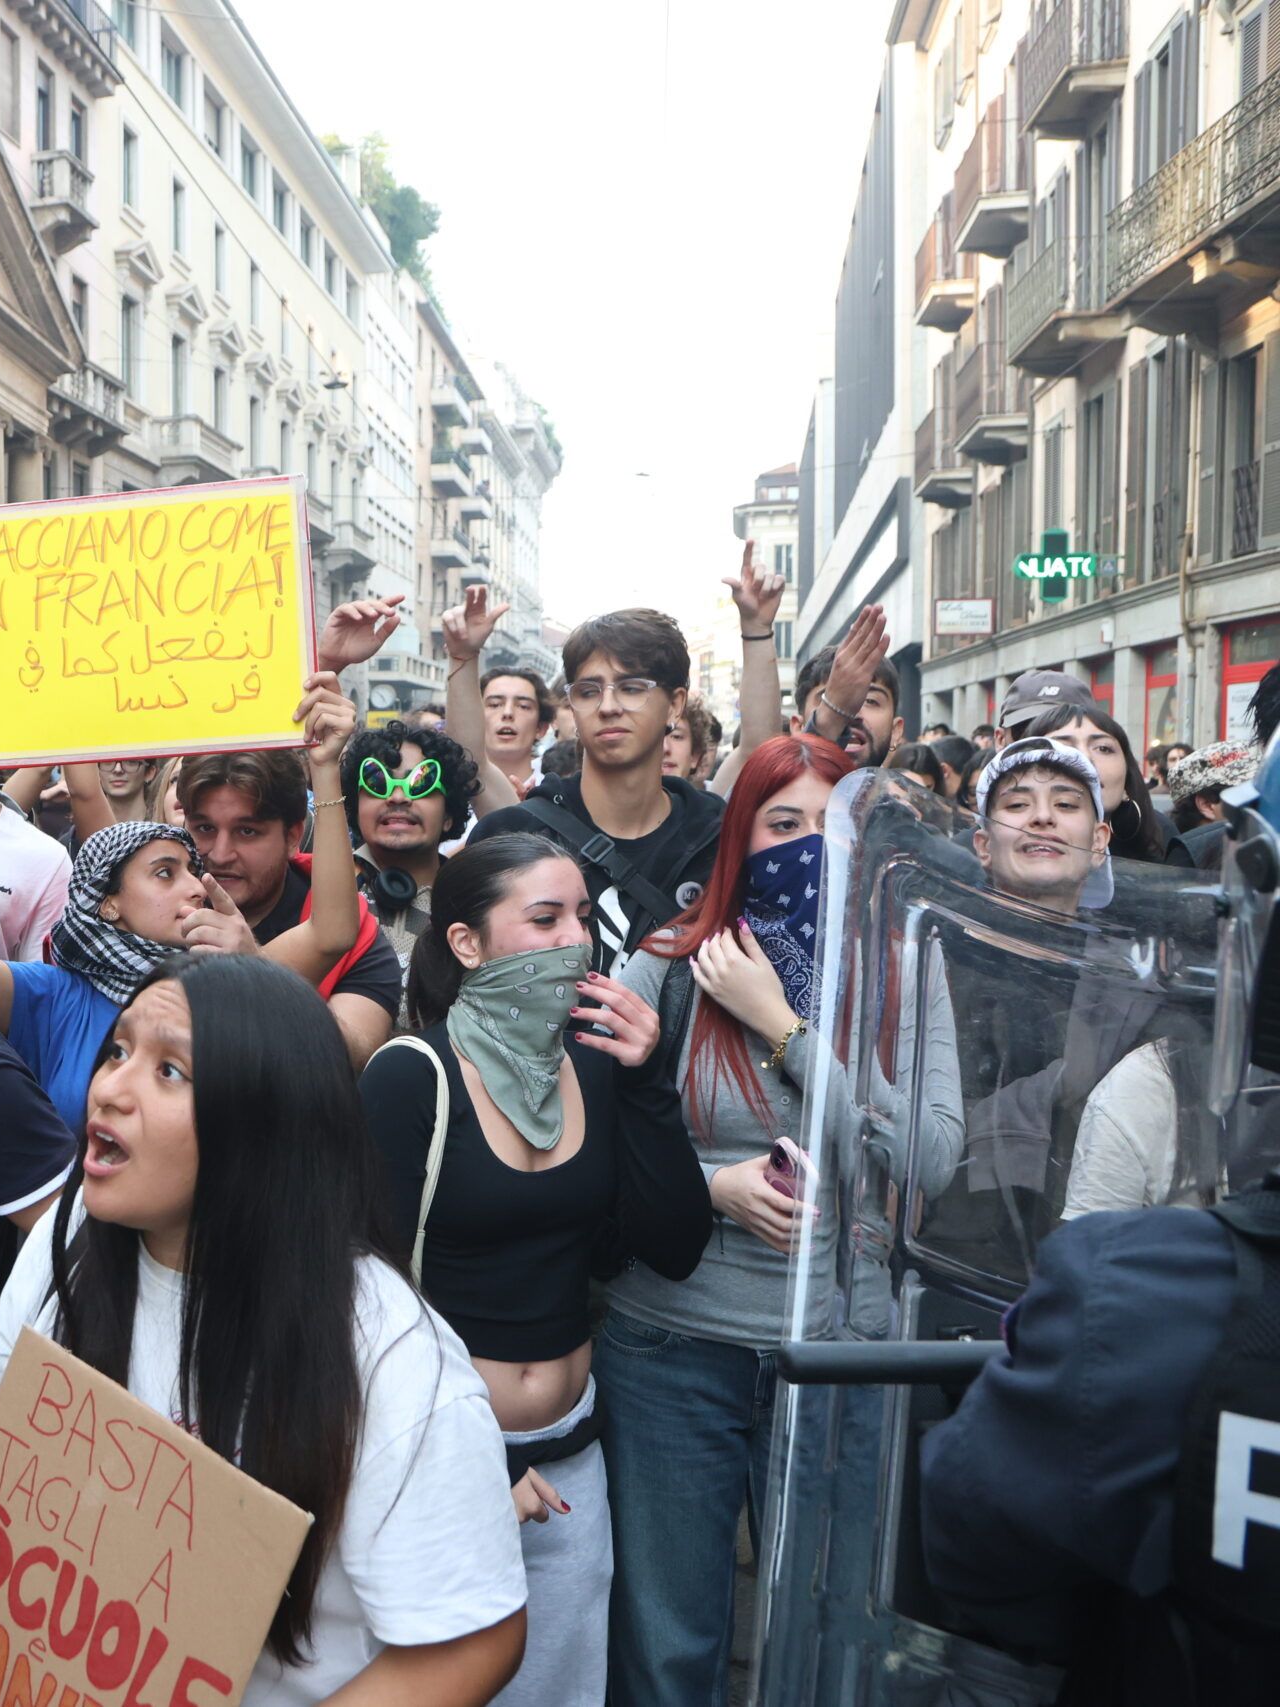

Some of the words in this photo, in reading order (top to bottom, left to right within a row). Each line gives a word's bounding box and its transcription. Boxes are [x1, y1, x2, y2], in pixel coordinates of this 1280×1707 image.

[179, 502, 293, 554] COME
[33, 550, 286, 633] FRANCIA!
[19, 639, 45, 694] في
[61, 629, 121, 679] كما
[28, 1362, 195, 1550] BASTA
[135, 1548, 173, 1623] A
